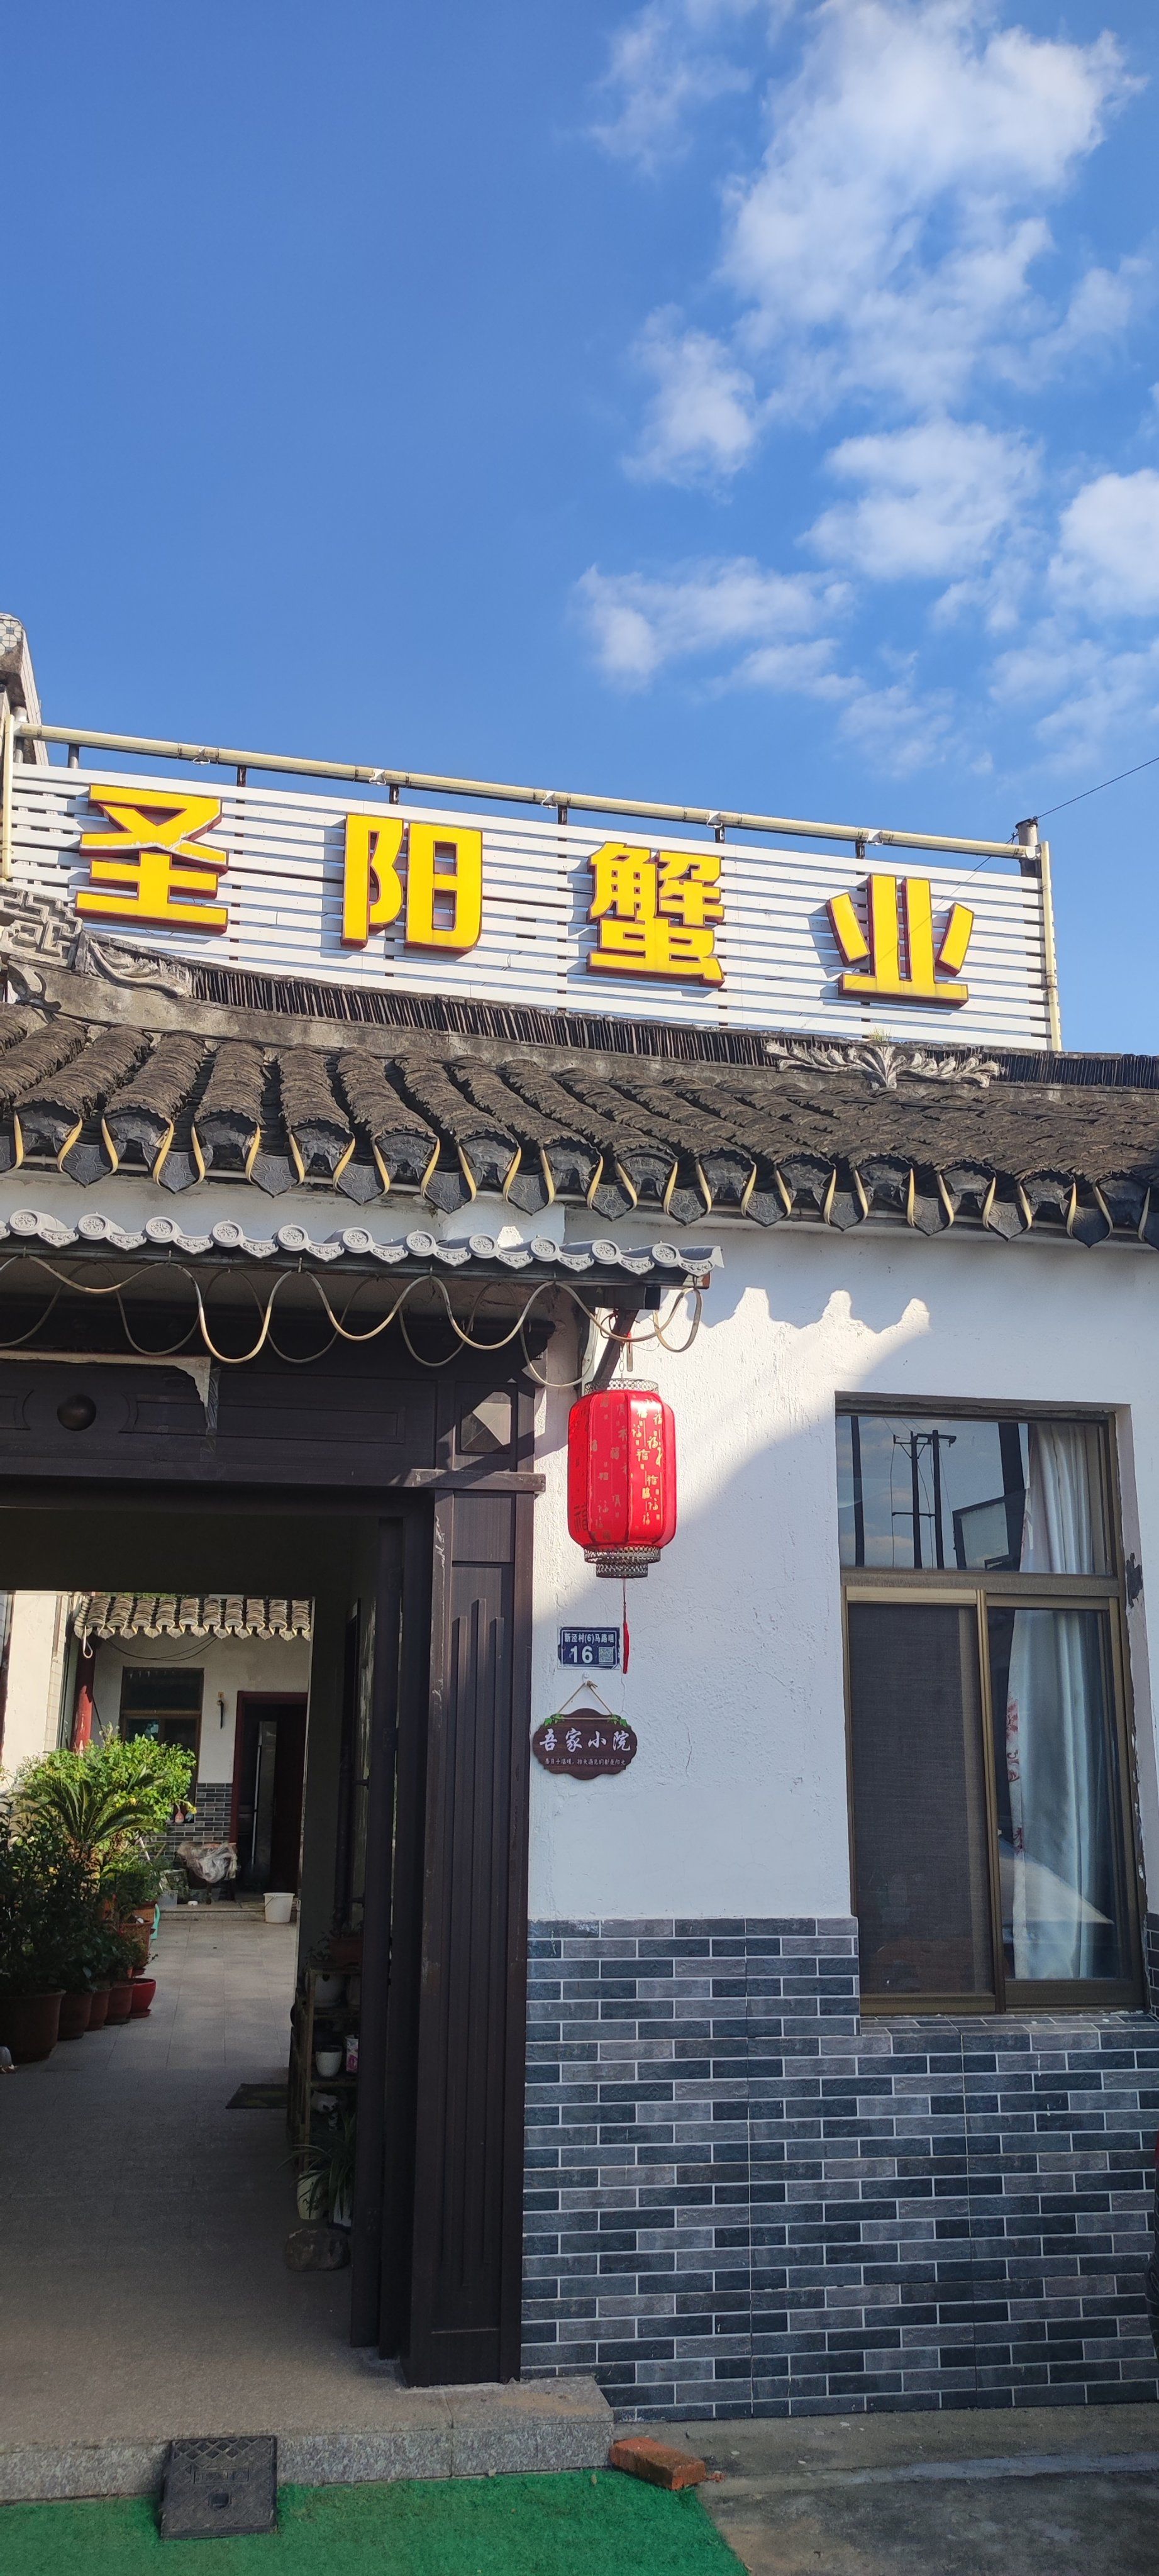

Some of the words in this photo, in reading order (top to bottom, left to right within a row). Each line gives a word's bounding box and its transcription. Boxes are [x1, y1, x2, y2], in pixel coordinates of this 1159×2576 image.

[74, 783, 975, 1005] 圣阳蟹业
[570, 1645, 593, 1663] 16
[539, 1728, 631, 1752] 吾家小院
